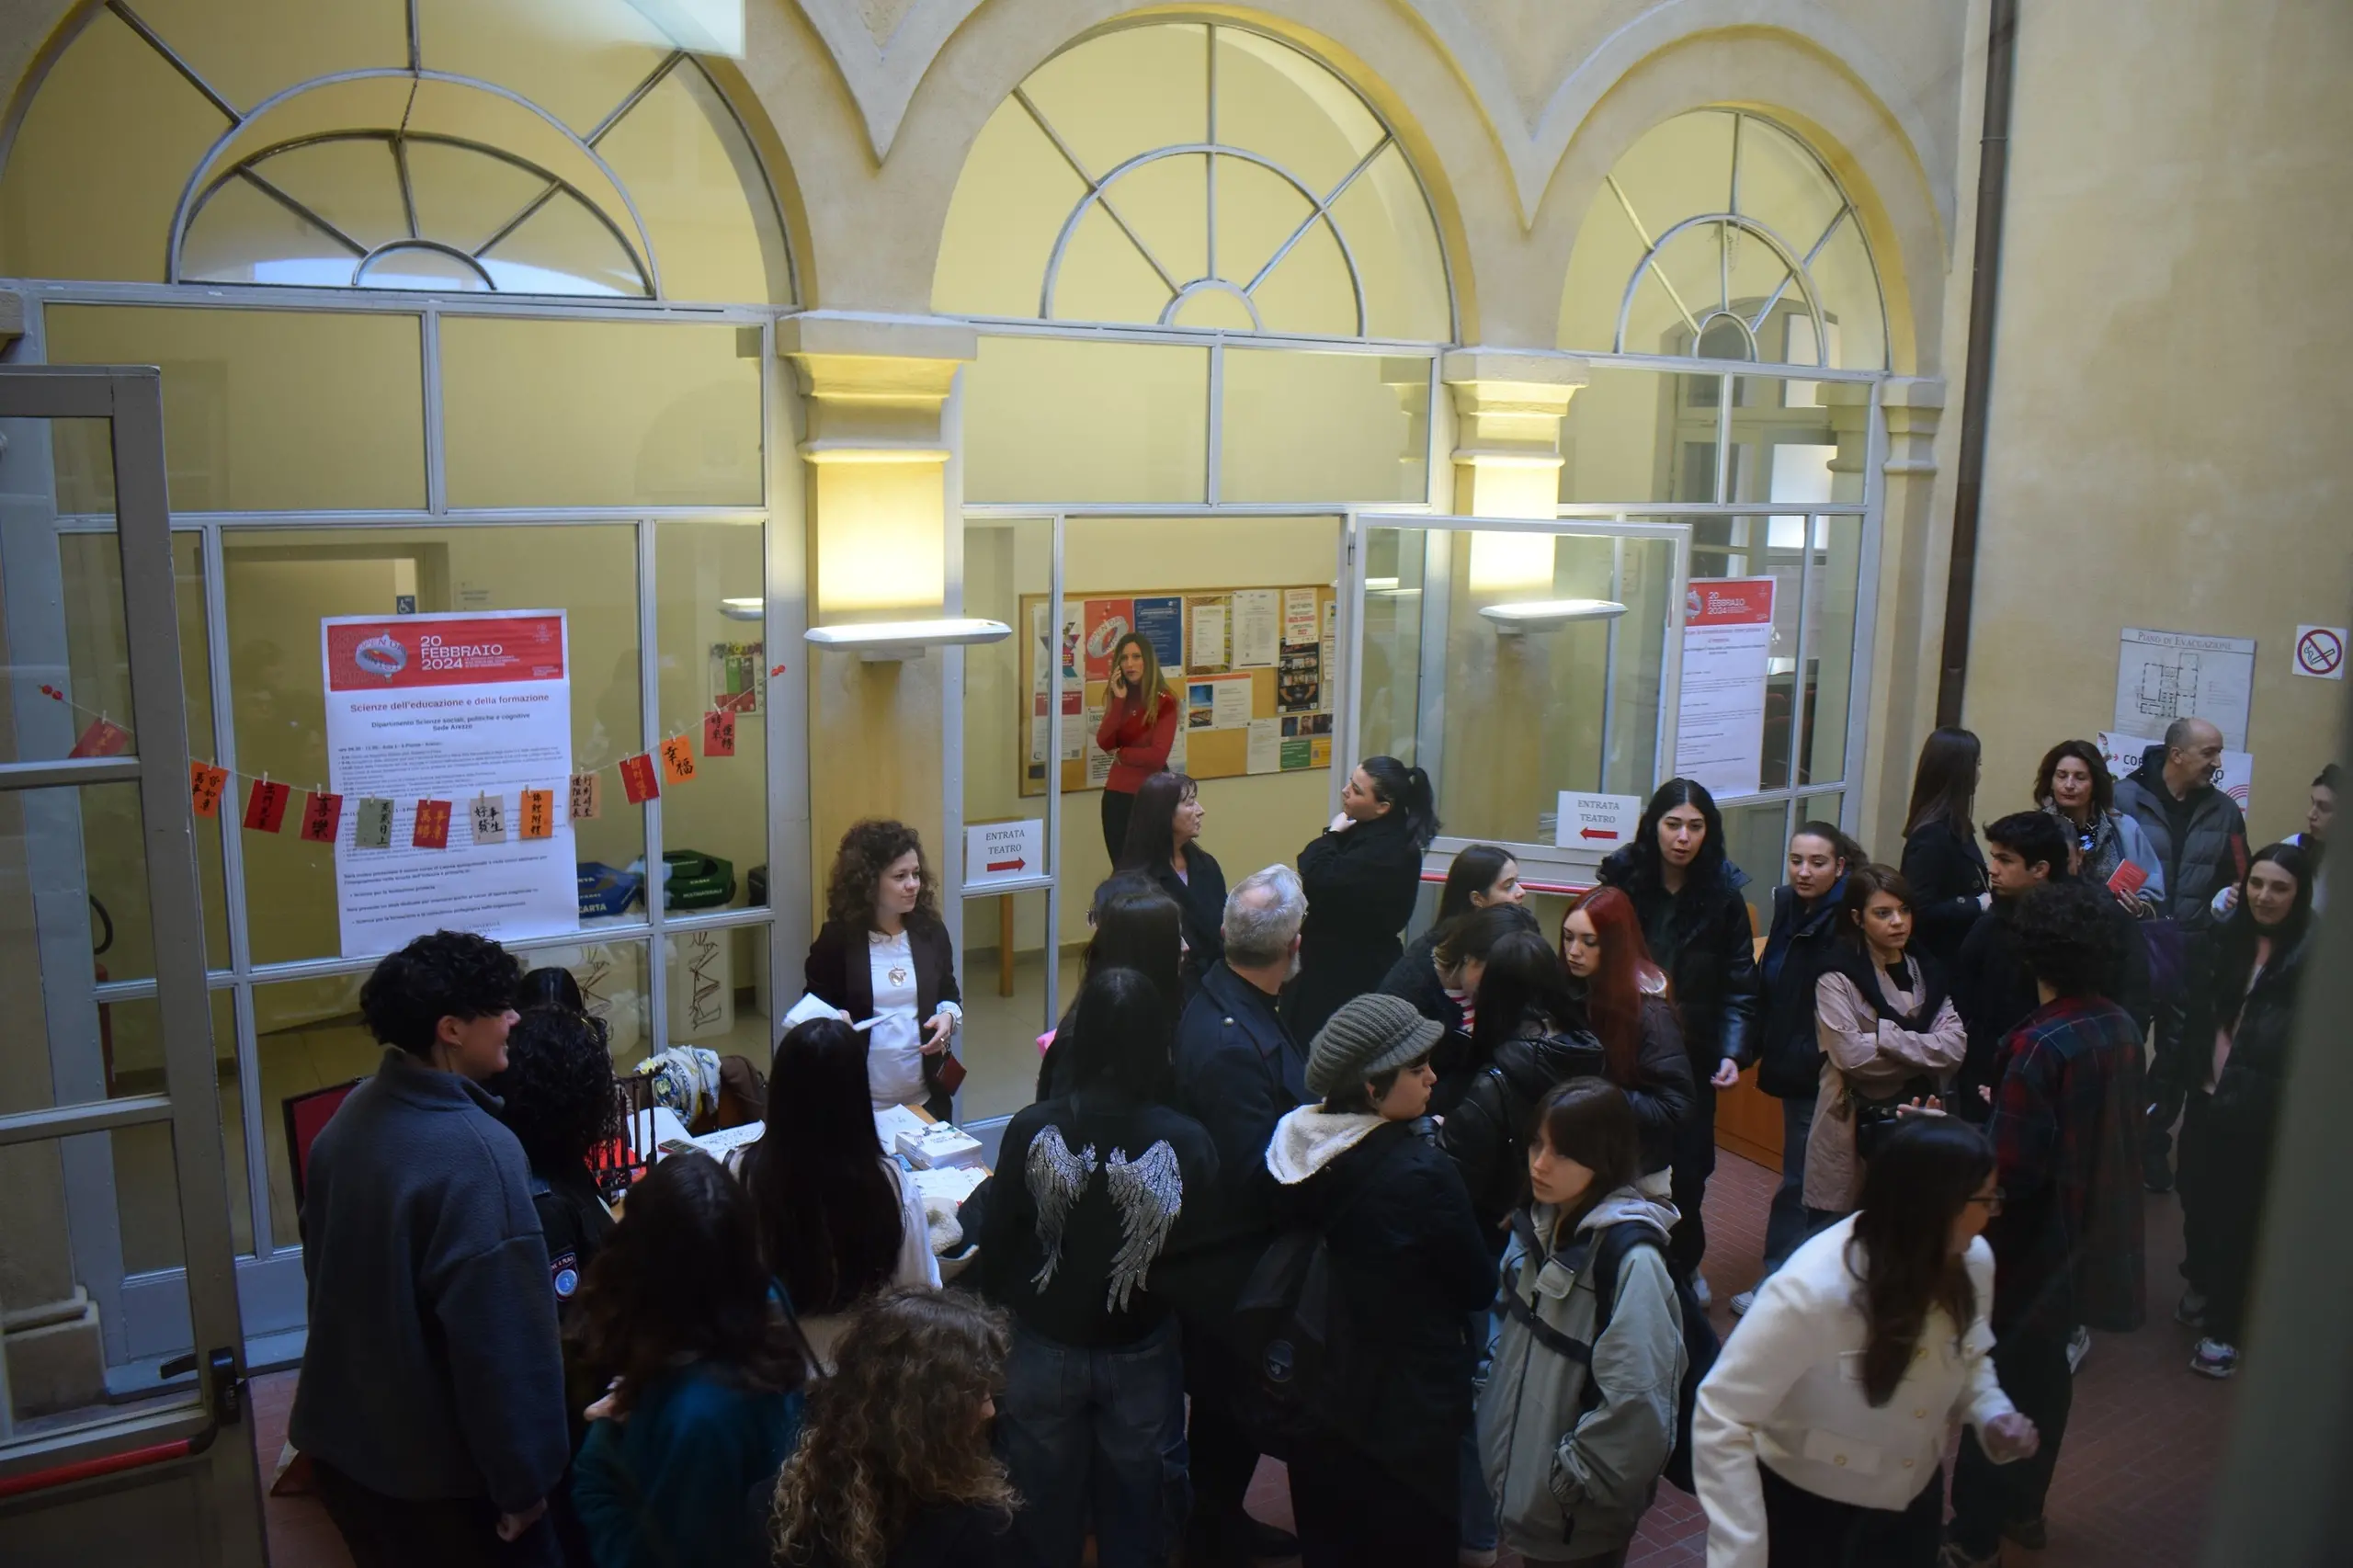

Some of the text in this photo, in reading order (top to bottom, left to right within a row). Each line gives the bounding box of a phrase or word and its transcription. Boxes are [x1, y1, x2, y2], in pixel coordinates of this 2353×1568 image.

[1708, 591, 1719, 599] 20
[420, 635, 442, 648] 20
[421, 644, 503, 659] FEBBRAIO
[422, 658, 462, 671] 2024
[350, 703, 388, 713] Scienze
[390, 699, 464, 711] dell'educazione
[474, 697, 496, 706] della
[499, 694, 550, 704] formazione
[664, 745, 693, 776] 幸福
[1577, 799, 1620, 811] ENTRATA
[1579, 812, 1617, 824] TEATRO
[985, 829, 1026, 841] ENTRATA
[988, 844, 1022, 855] TEATRO
